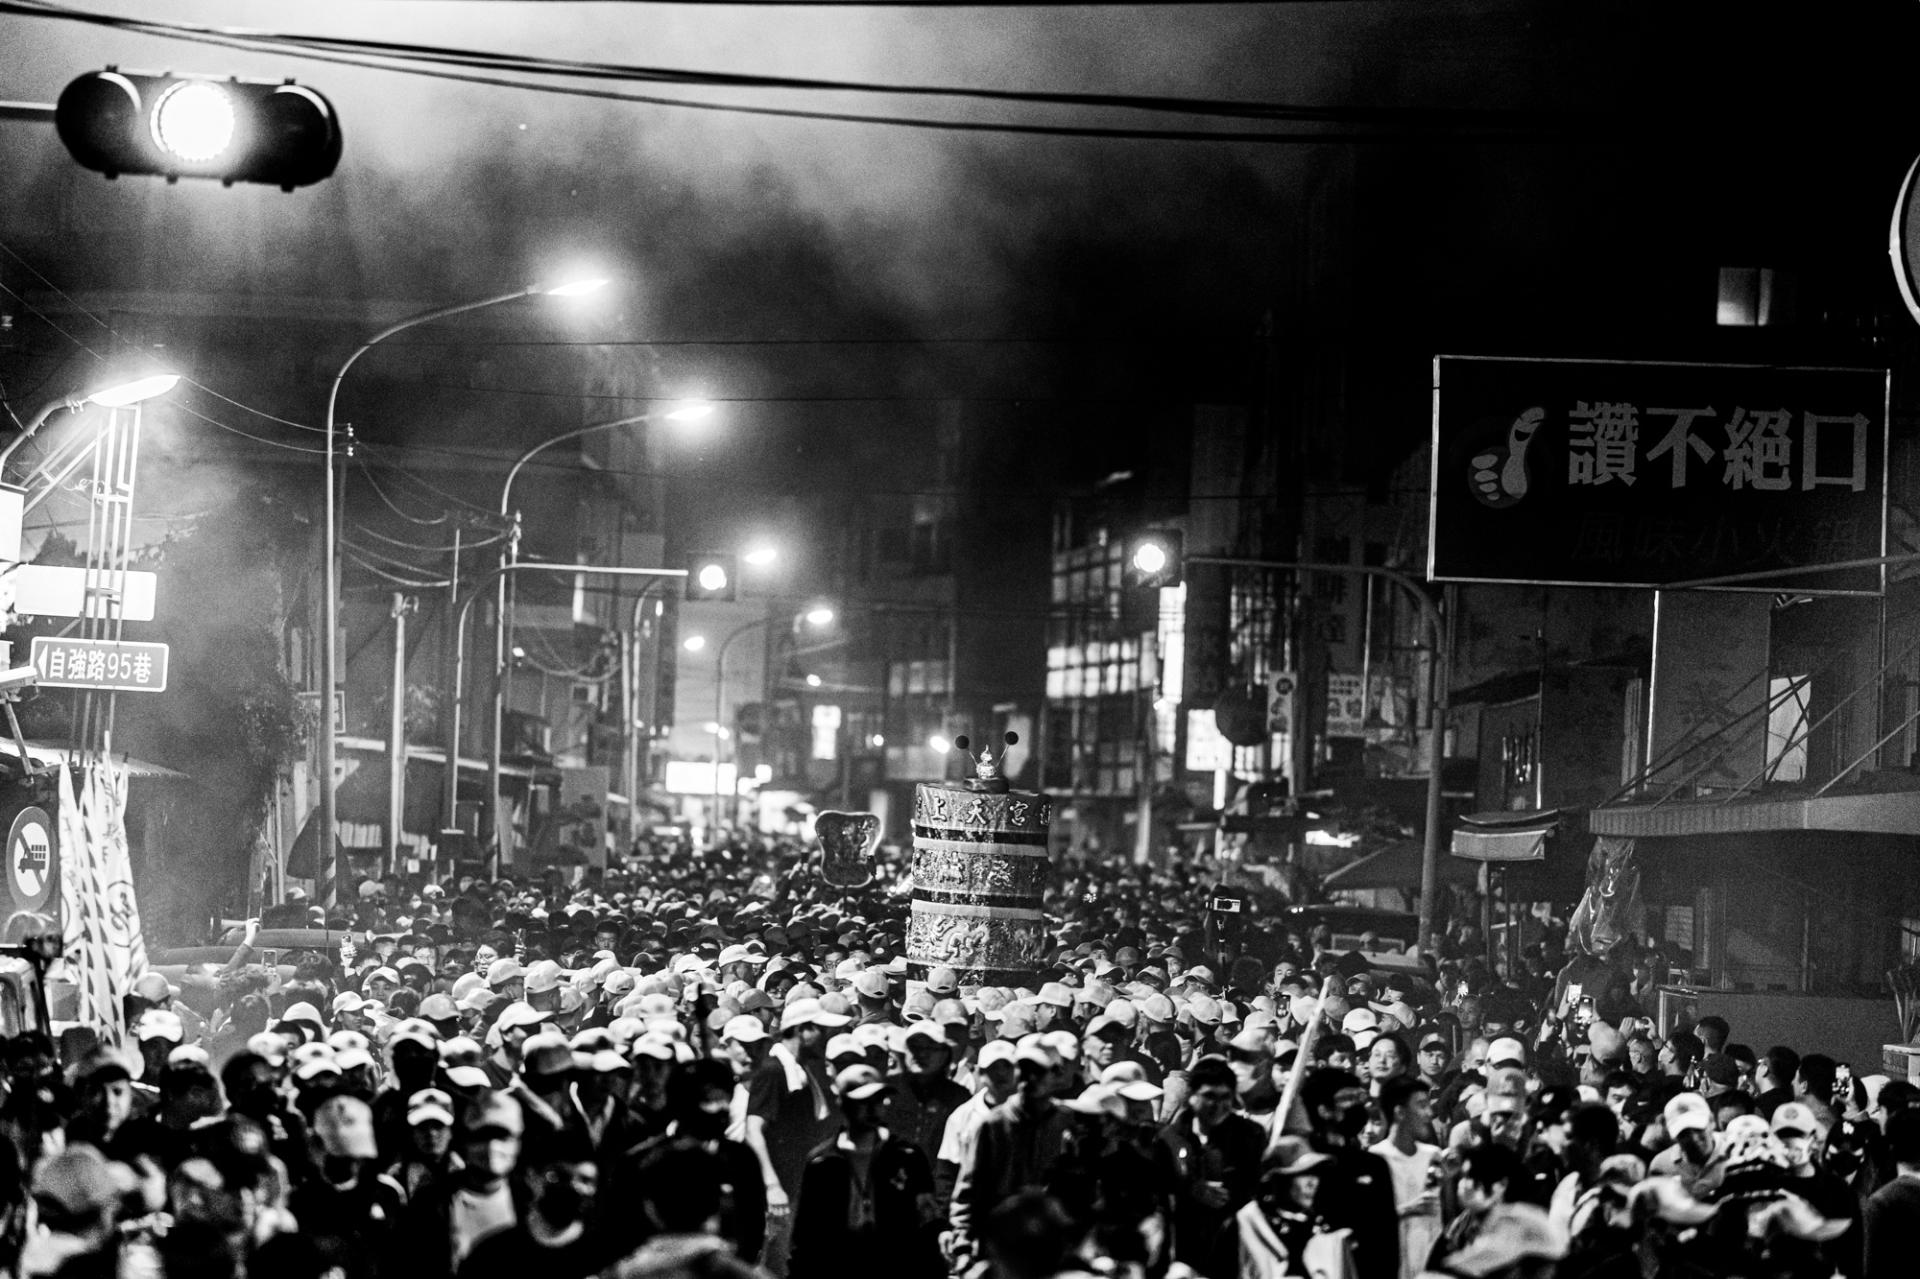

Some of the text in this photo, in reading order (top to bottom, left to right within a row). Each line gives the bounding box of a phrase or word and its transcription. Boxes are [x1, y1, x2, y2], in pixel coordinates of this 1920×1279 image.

[1567, 400, 1871, 493] 讚不絕口
[49, 647, 152, 684] 自強路95巷
